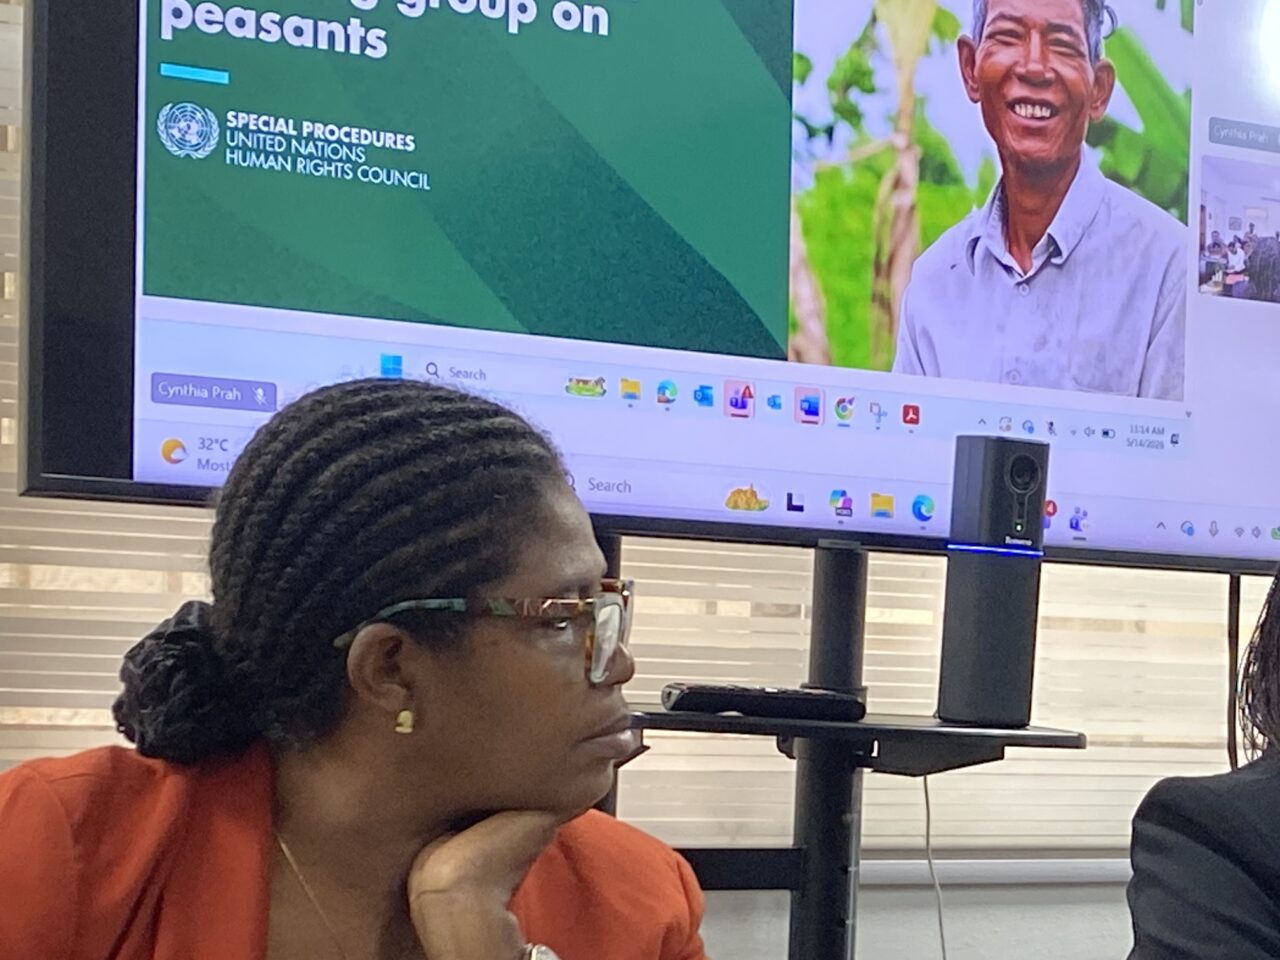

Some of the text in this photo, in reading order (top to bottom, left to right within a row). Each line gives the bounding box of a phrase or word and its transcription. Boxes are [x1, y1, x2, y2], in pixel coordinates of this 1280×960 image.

[161, 0, 388, 59] peasants
[552, 1, 609, 35] on
[226, 111, 416, 151] SPECIAL PROCEDURES
[226, 130, 366, 163] UNITED NATIONS
[226, 149, 431, 190] HUMAN RIGHTS COUNCIL
[449, 366, 487, 381] Search
[158, 381, 242, 401] Cynthia Prah
[198, 437, 229, 452] 32°C
[197, 458, 233, 472] Most
[588, 477, 632, 494] Search
